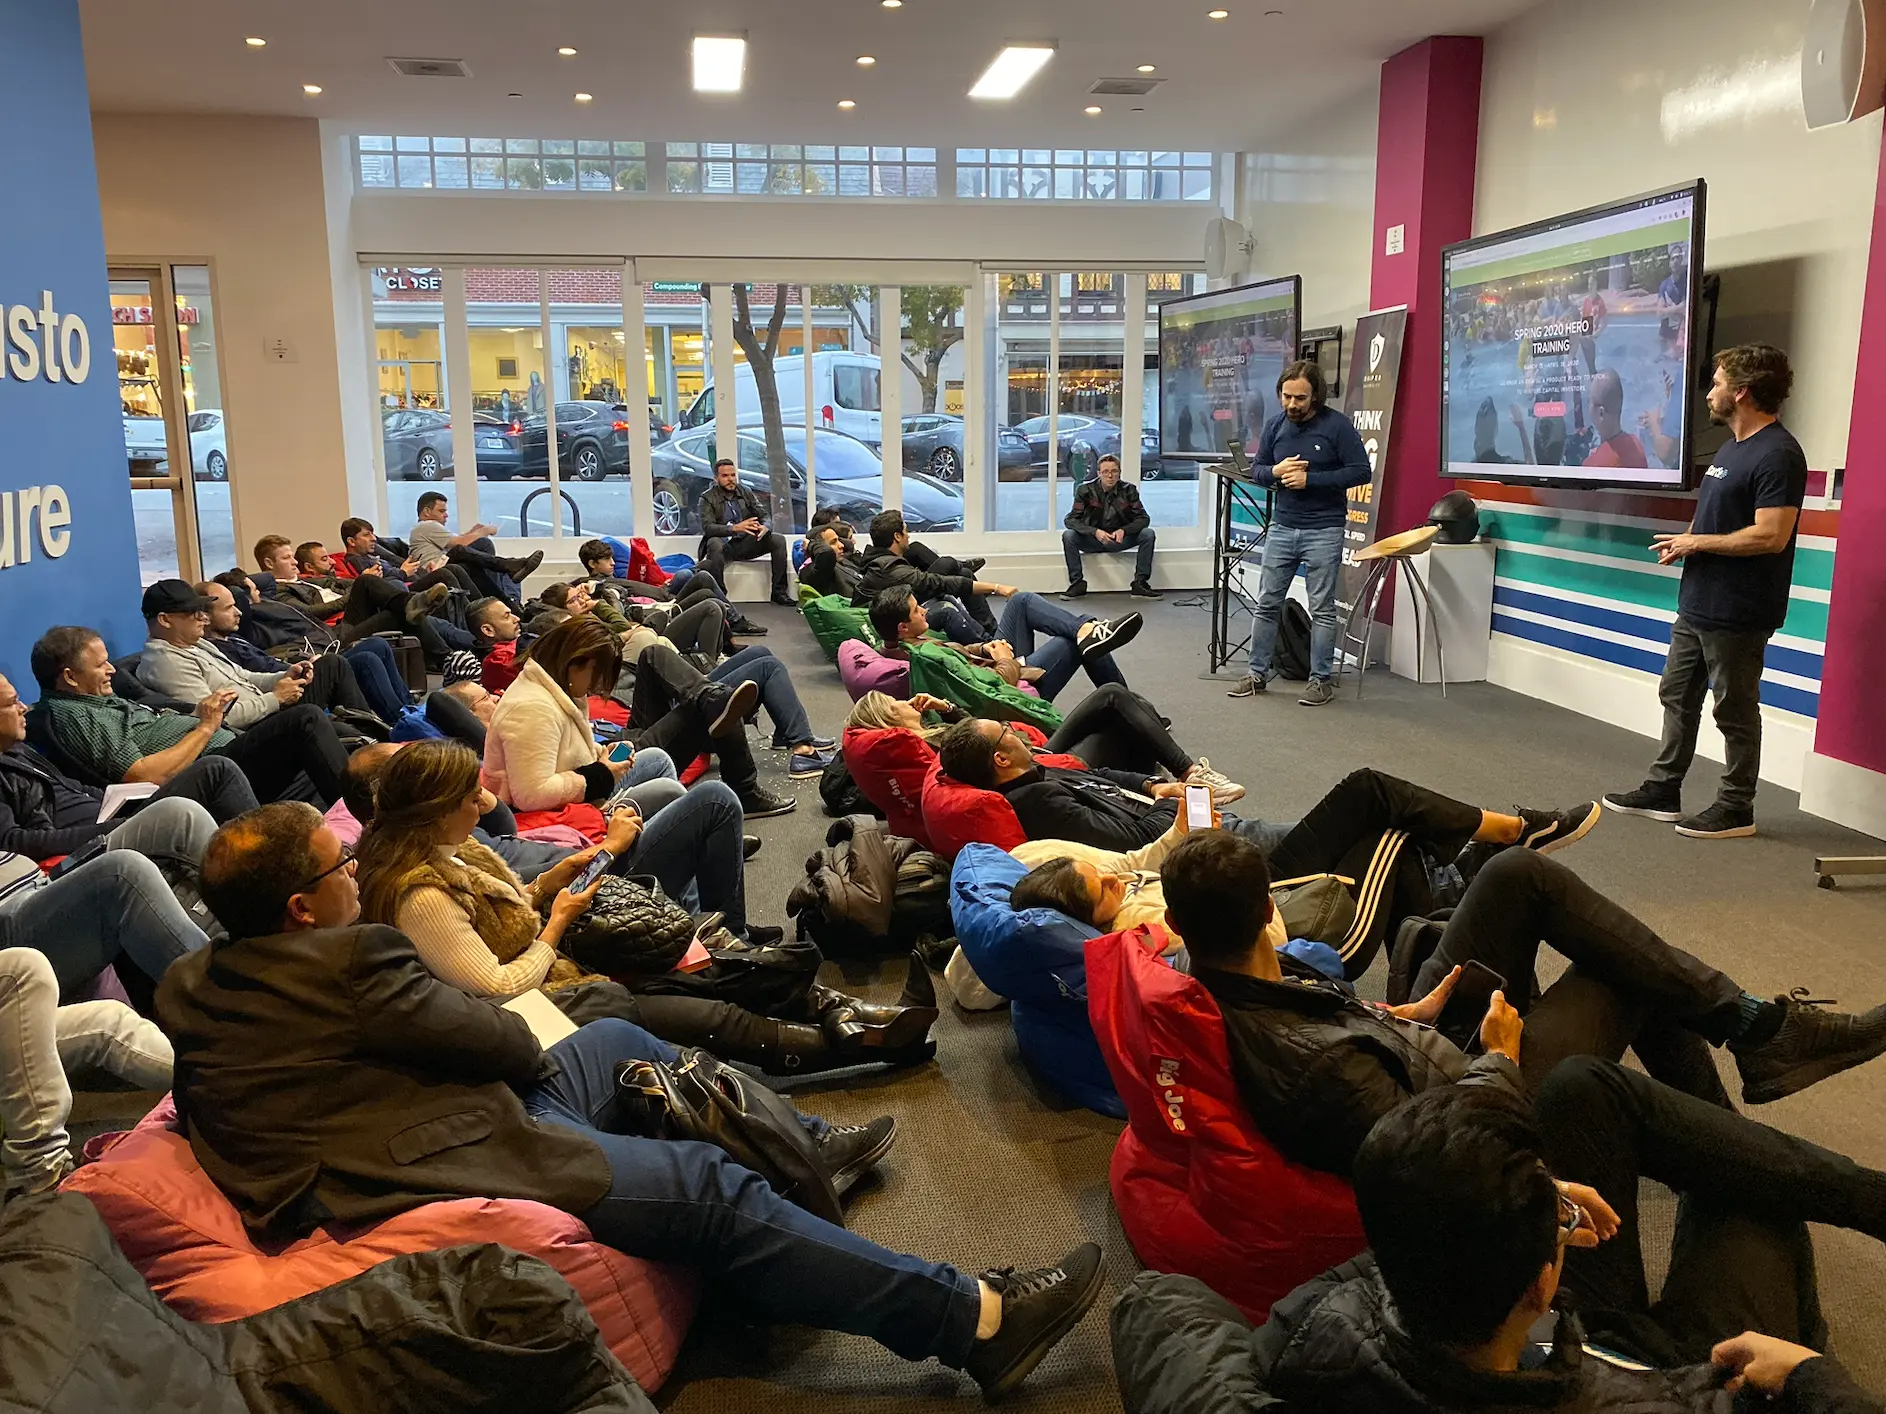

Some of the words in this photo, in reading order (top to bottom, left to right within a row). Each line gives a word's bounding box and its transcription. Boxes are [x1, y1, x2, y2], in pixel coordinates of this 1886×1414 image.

[386, 276, 442, 289] CLOSE
[654, 282, 698, 291] Compounding
[0, 290, 91, 384] sto
[1514, 327, 1542, 340] SPRING
[1543, 323, 1564, 337] 2020
[1565, 319, 1590, 334] HERO
[1532, 339, 1570, 354] TRAINING
[1155, 1059, 1180, 1087] Big
[1164, 1089, 1186, 1131] Joe
